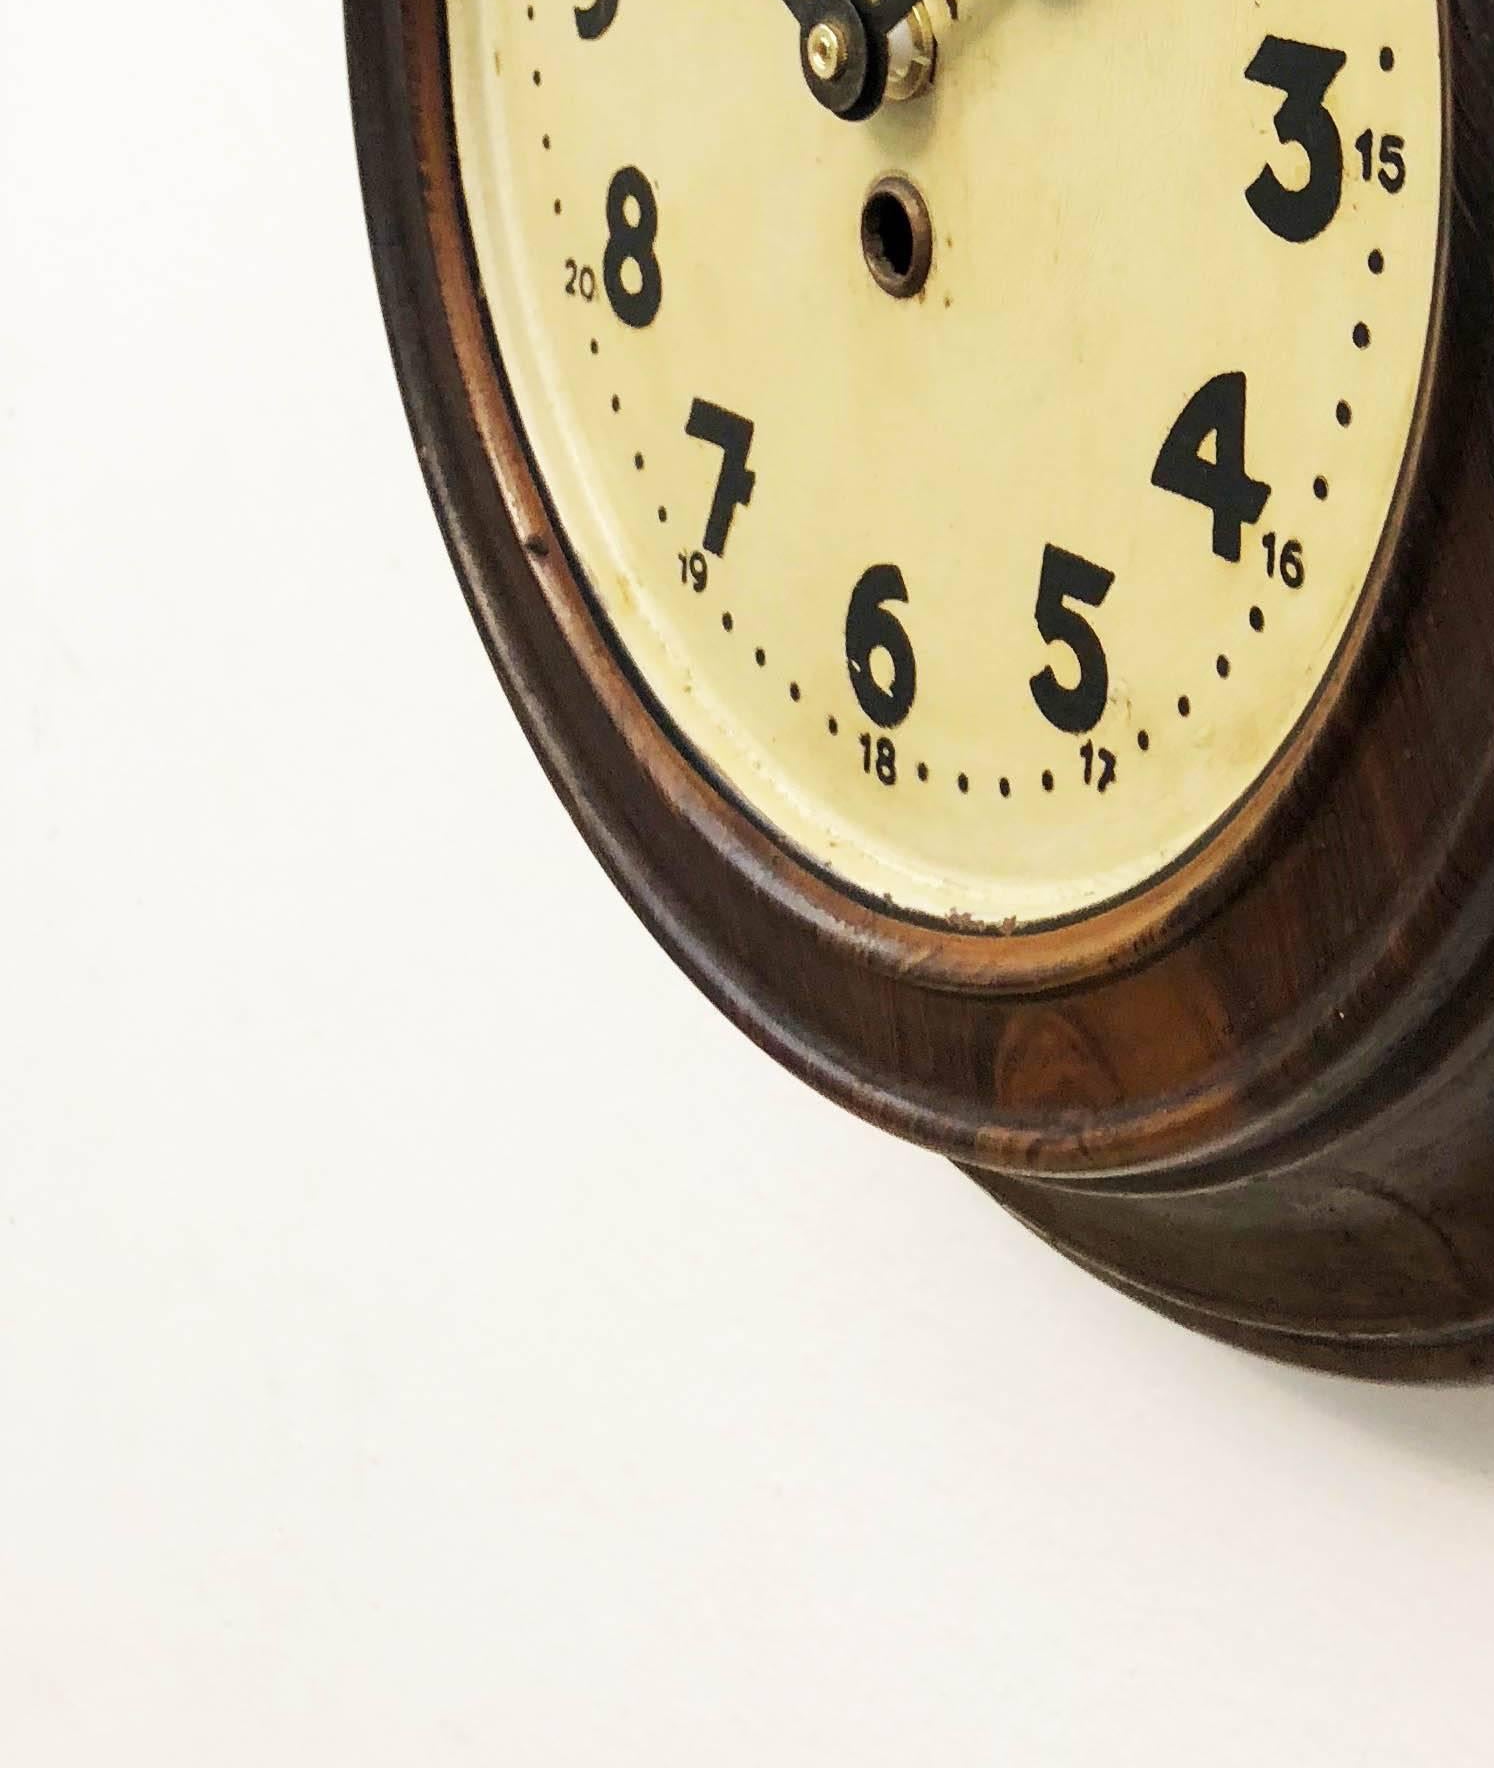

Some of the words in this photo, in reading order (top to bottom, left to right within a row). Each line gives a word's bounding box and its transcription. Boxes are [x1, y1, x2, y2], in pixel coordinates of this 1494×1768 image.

[1243, 34, 1347, 244] 3
[1354, 127, 1406, 194] 15
[564, 258, 596, 302] 20
[602, 166, 663, 329] 8
[685, 397, 756, 559] 7
[1150, 371, 1272, 563] 4
[677, 549, 709, 593] 19
[1262, 531, 1305, 590] 16
[844, 564, 917, 730] 6
[1029, 543, 1116, 736] 5
[858, 731, 897, 786] 18
[1079, 738, 1117, 793] 17
